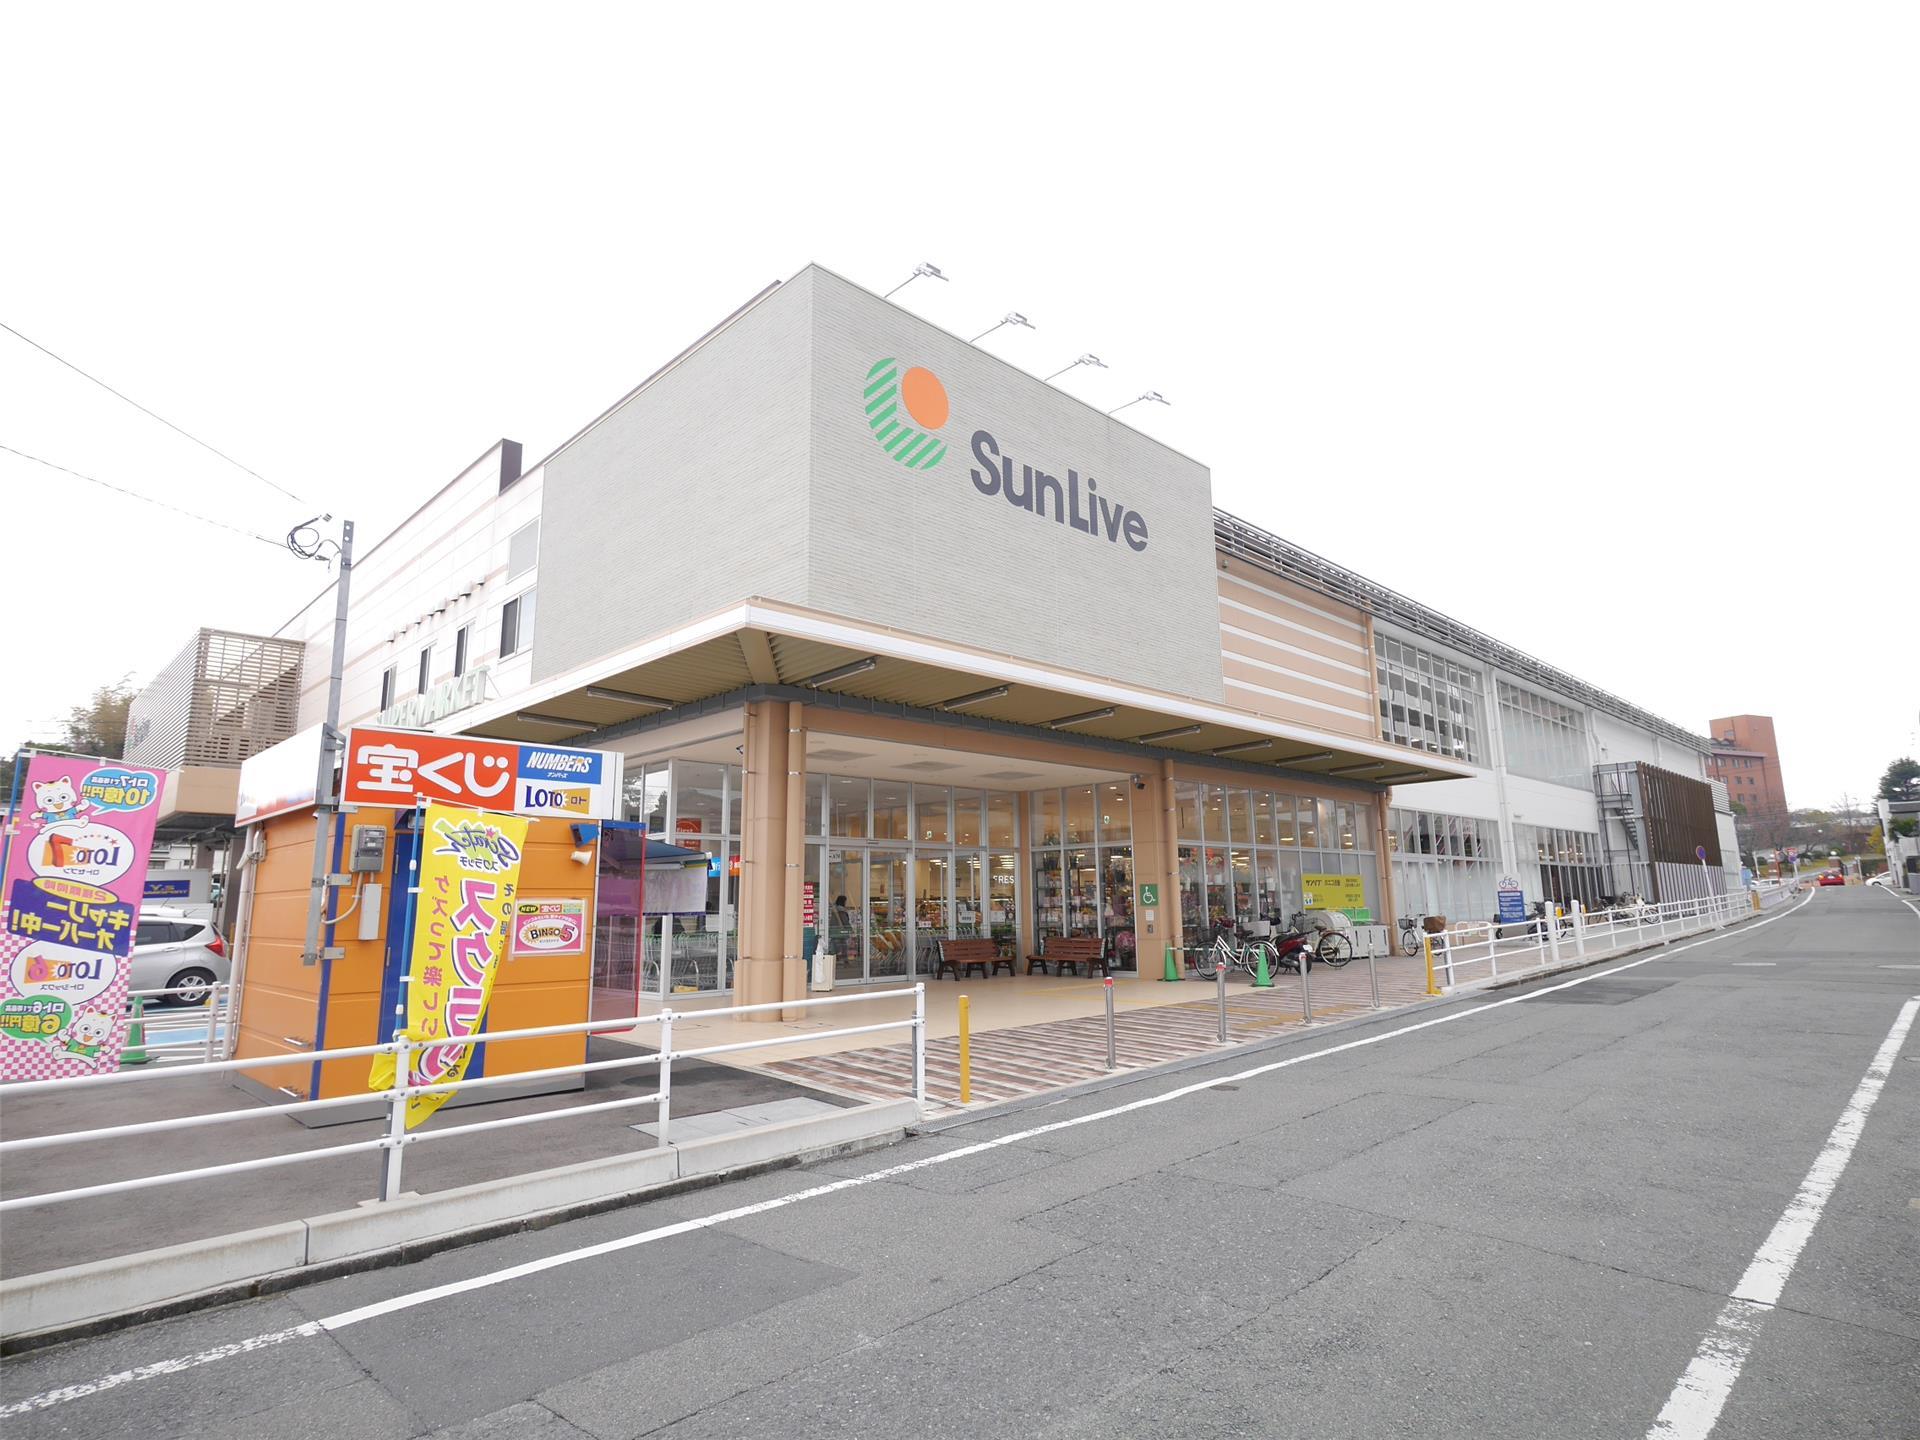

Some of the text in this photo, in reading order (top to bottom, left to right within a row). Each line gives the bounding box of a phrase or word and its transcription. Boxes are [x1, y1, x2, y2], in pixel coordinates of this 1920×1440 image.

[970, 430, 1148, 552] SunLive
[356, 743, 510, 798] 宝くじ
[526, 751, 593, 773] NUMBERS
[525, 785, 587, 808] LOTO ロト
[521, 905, 537, 913] NEW
[530, 924, 576, 943] BINGO 5
